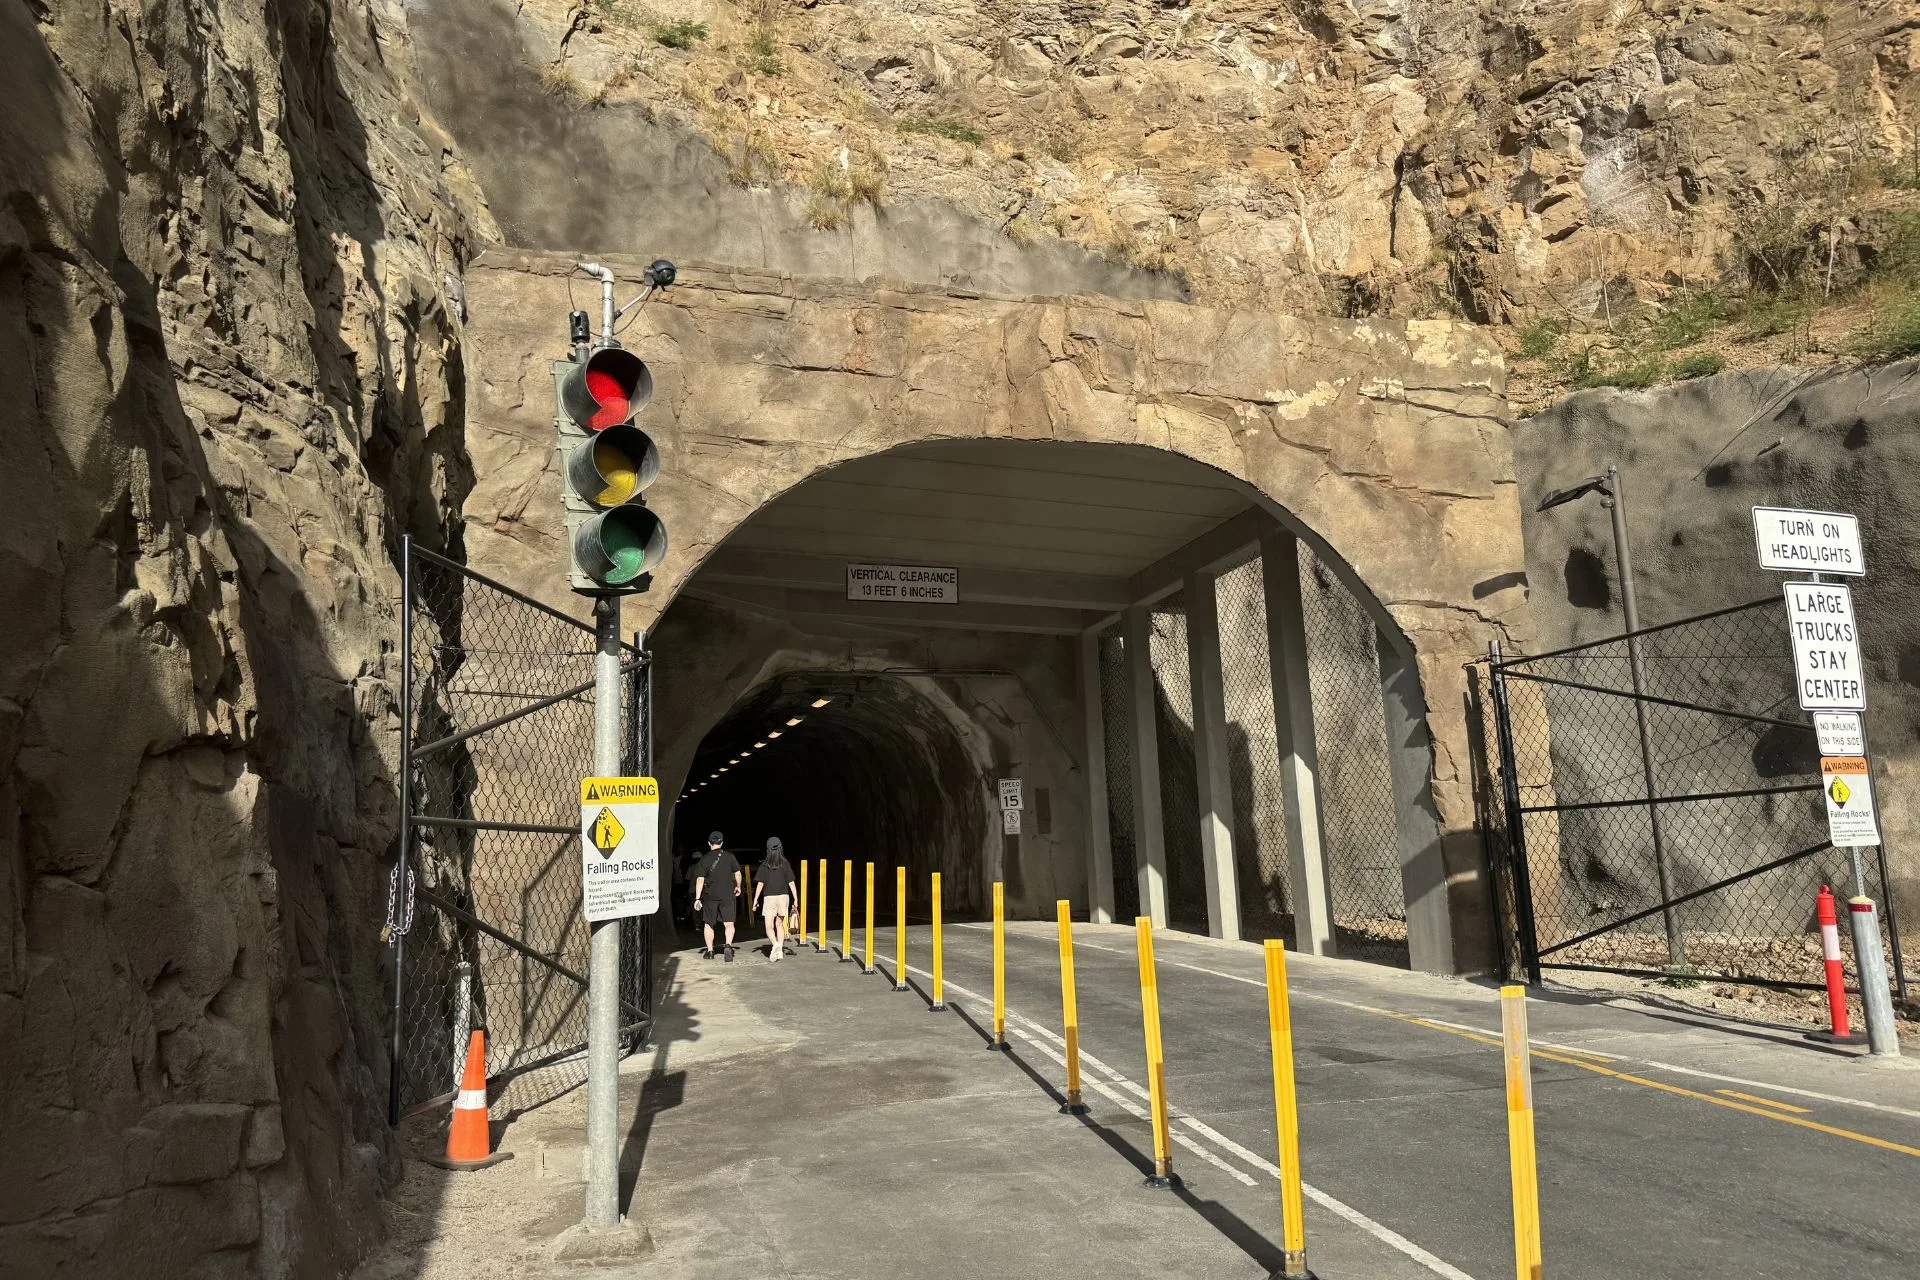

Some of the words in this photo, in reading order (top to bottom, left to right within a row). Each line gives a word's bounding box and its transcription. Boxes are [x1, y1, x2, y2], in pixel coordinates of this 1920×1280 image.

[1779, 519, 1815, 537] TURN
[1822, 523, 1840, 539] ON
[1771, 543, 1852, 563] HEADLIGHTS
[850, 569, 896, 581] VERTICAL
[899, 571, 956, 584] CLEARANCE
[862, 585, 872, 596] 13
[874, 585, 897, 596] FEET
[901, 586, 907, 597] 6
[909, 587, 944, 598] INCHES
[1795, 593, 1844, 614] LARGE
[1795, 621, 1853, 642] TRUCKS
[1809, 650, 1847, 670] STAY
[1804, 678, 1860, 699] CENTER
[1820, 722, 1829, 730] NO
[1831, 722, 1857, 731] WALKING
[1821, 737, 1831, 745] ON
[1832, 736, 1845, 746] THIS
[1847, 737, 1860, 746] SIDE
[1831, 761, 1865, 770] WARNING
[600, 784, 656, 797] WARNING
[1003, 795, 1019, 807] 15
[1830, 810, 1850, 819] Falling
[587, 862, 619, 874] Falling
[621, 858, 654, 872] Rocks!
